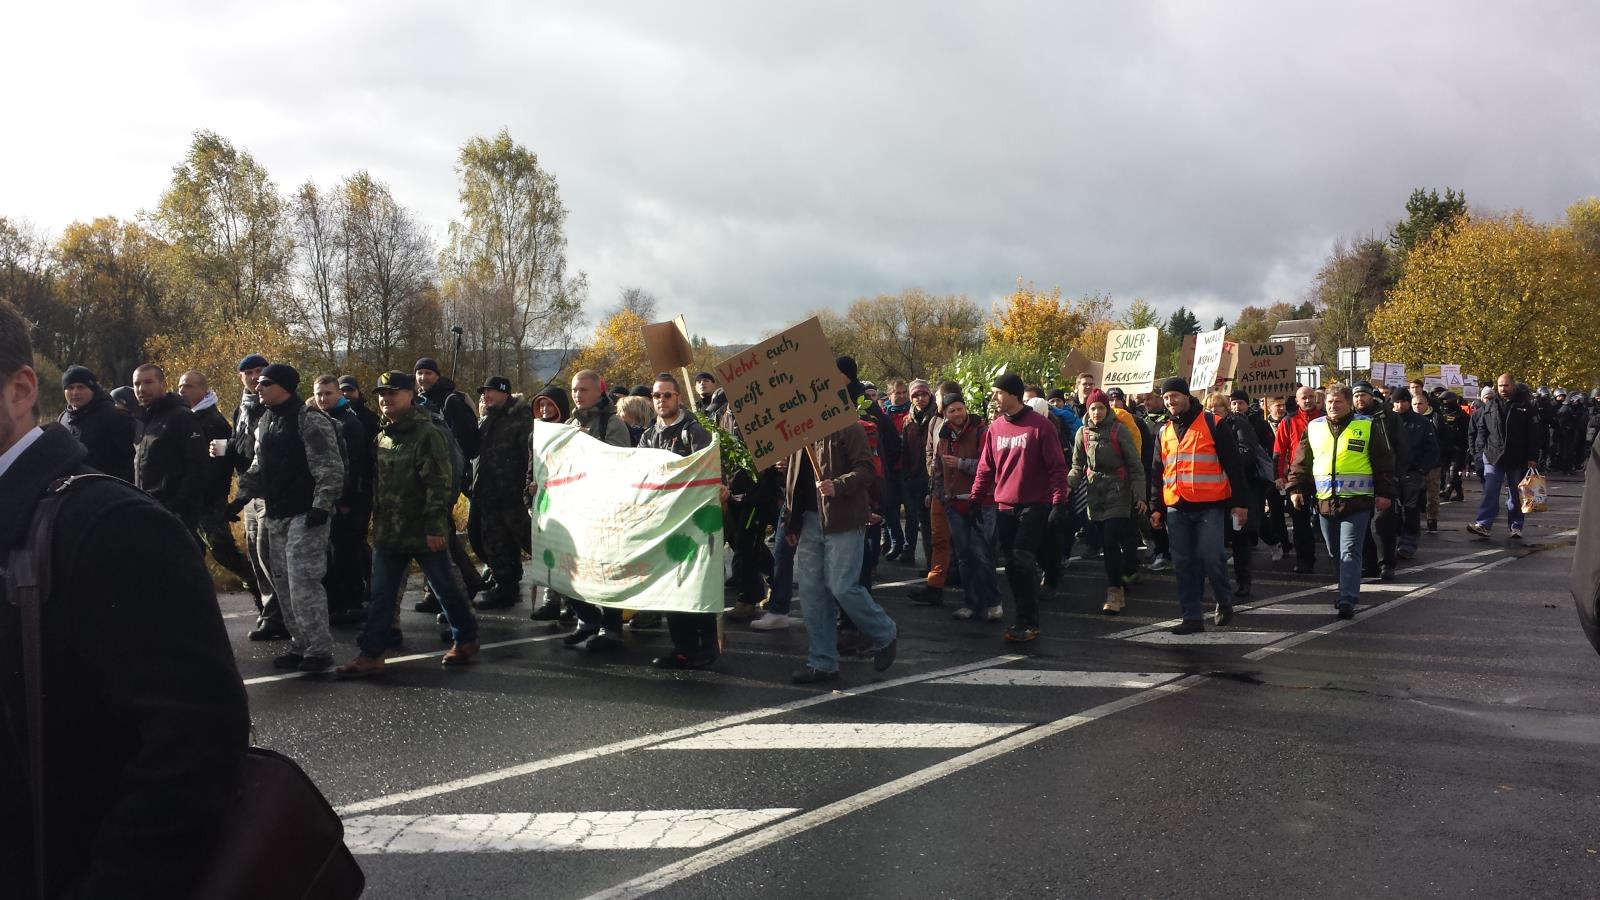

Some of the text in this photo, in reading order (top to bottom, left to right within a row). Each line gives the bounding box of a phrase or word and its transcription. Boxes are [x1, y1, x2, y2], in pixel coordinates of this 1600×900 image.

[1111, 350, 1142, 363] STOFF
[1249, 344, 1284, 357] WALD
[719, 335, 799, 384] Wehrt euch,
[1249, 359, 1271, 369] statt
[1104, 370, 1152, 382] ABGASMUFF
[1241, 369, 1289, 382] ASPHALT
[733, 370, 794, 414] greift ein,
[744, 377, 831, 435] setzt euch für
[754, 439, 775, 459] die
[774, 417, 814, 443] Tiere
